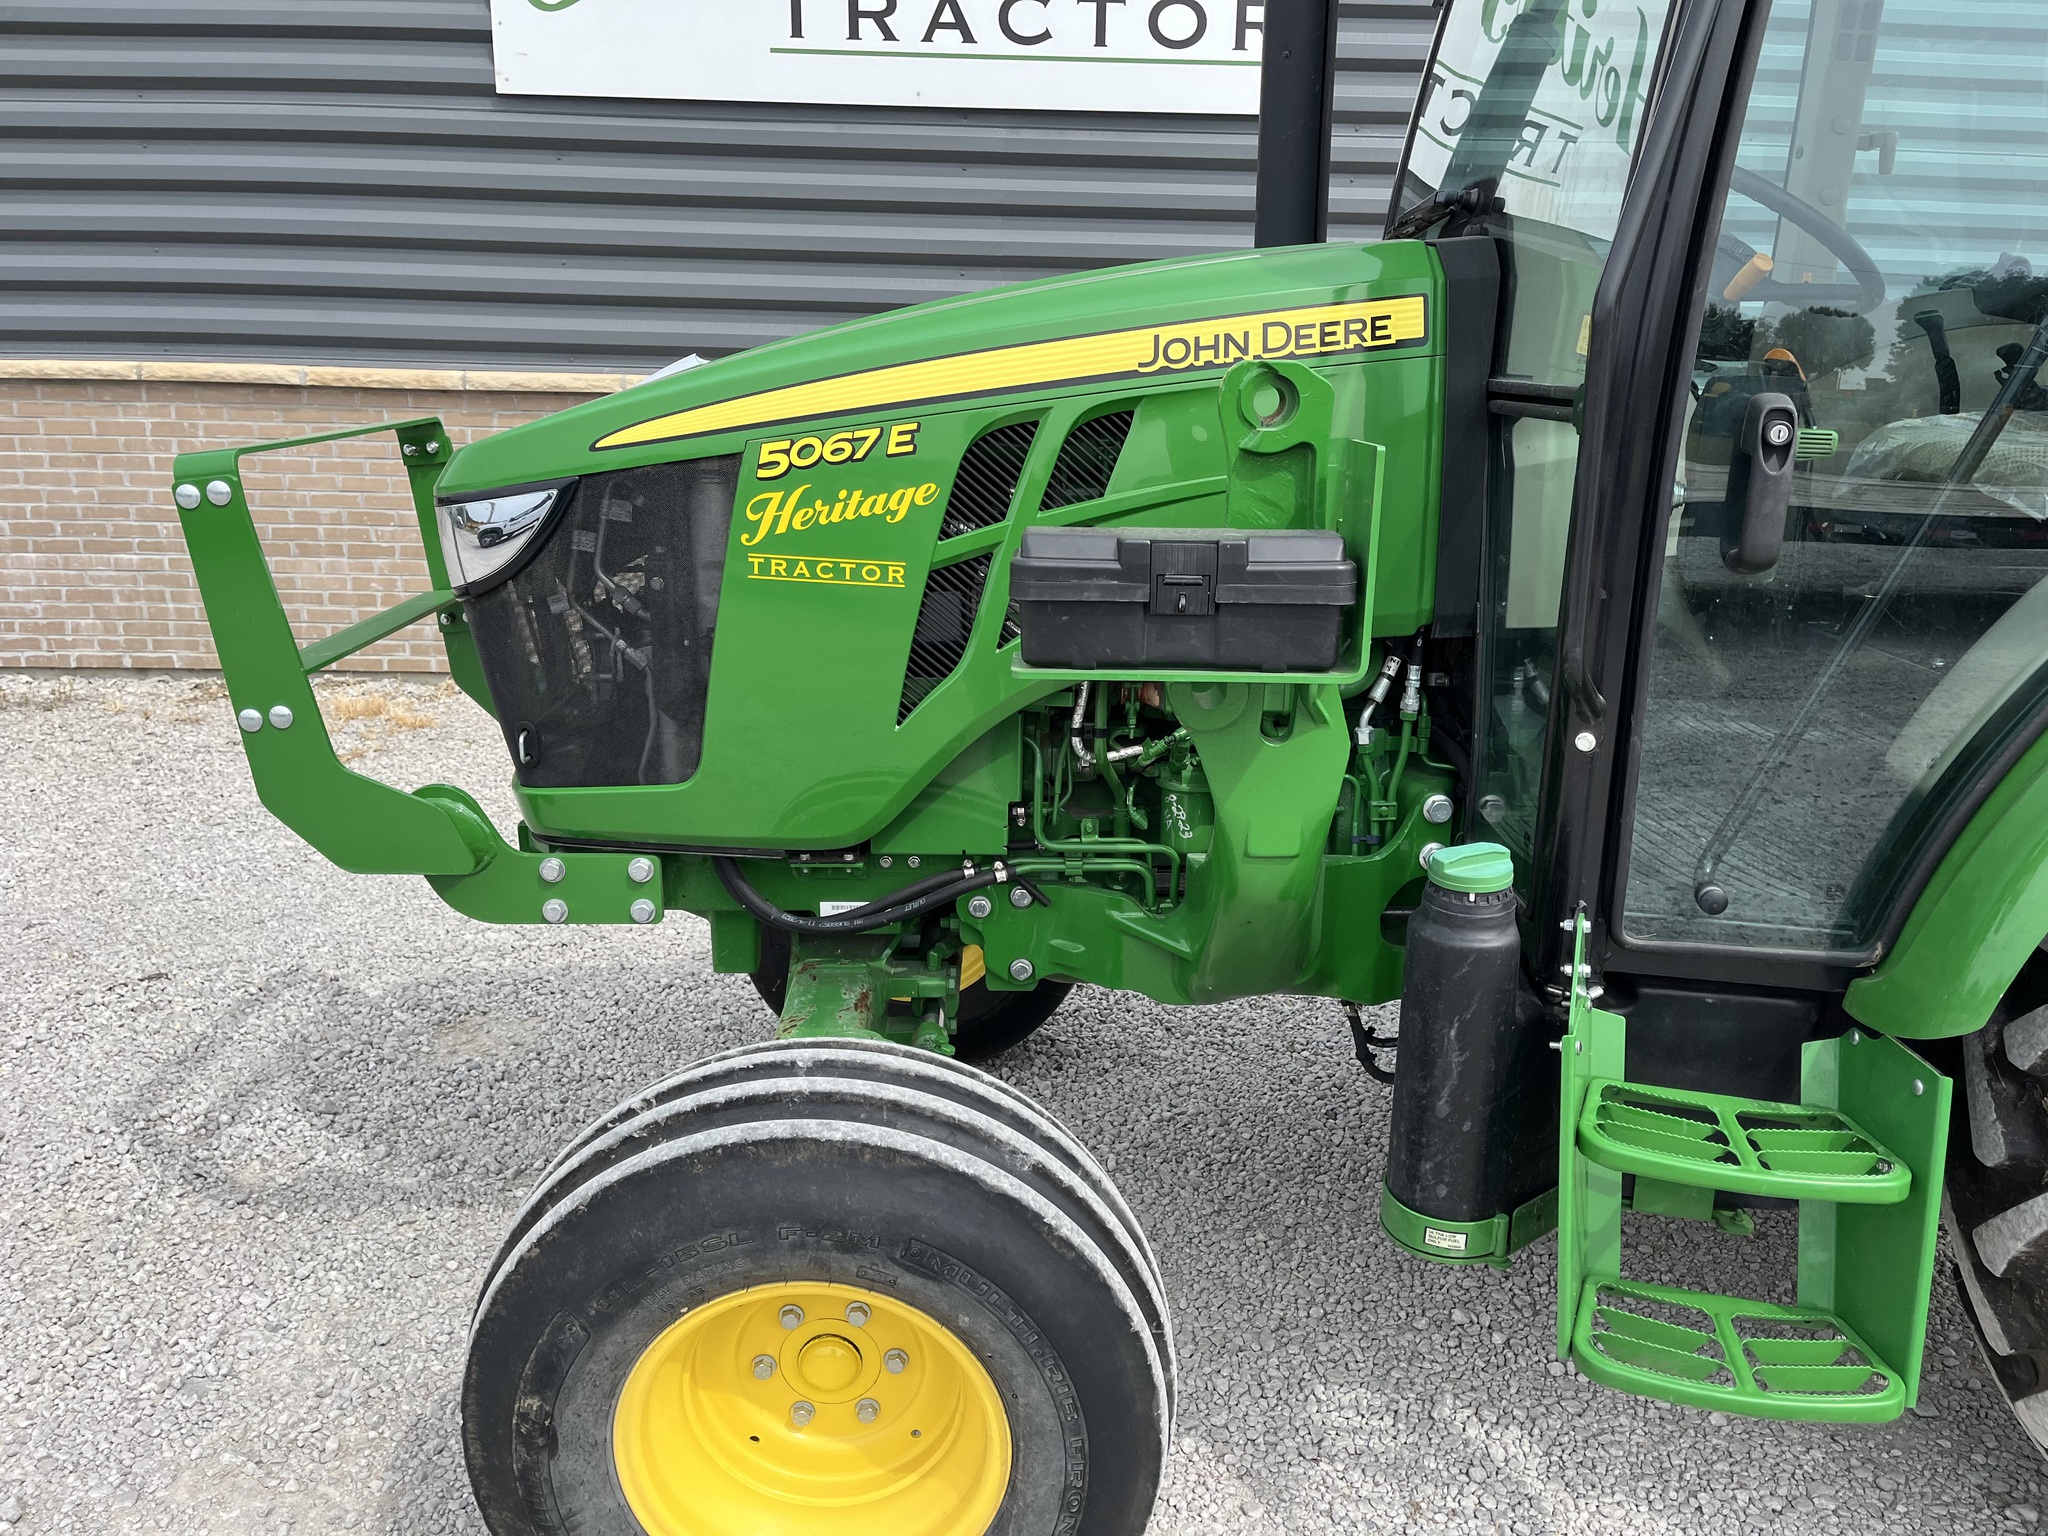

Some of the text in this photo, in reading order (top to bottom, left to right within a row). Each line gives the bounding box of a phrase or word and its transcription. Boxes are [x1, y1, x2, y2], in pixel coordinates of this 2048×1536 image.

[1137, 314, 1393, 369] JOHN DEERE
[756, 421, 921, 480] 5067 E
[740, 482, 941, 546] Heritage
[747, 557, 906, 584] TRACTOR
[778, 1226, 881, 1250] F-2M
[681, 1257, 748, 1286] RATING
